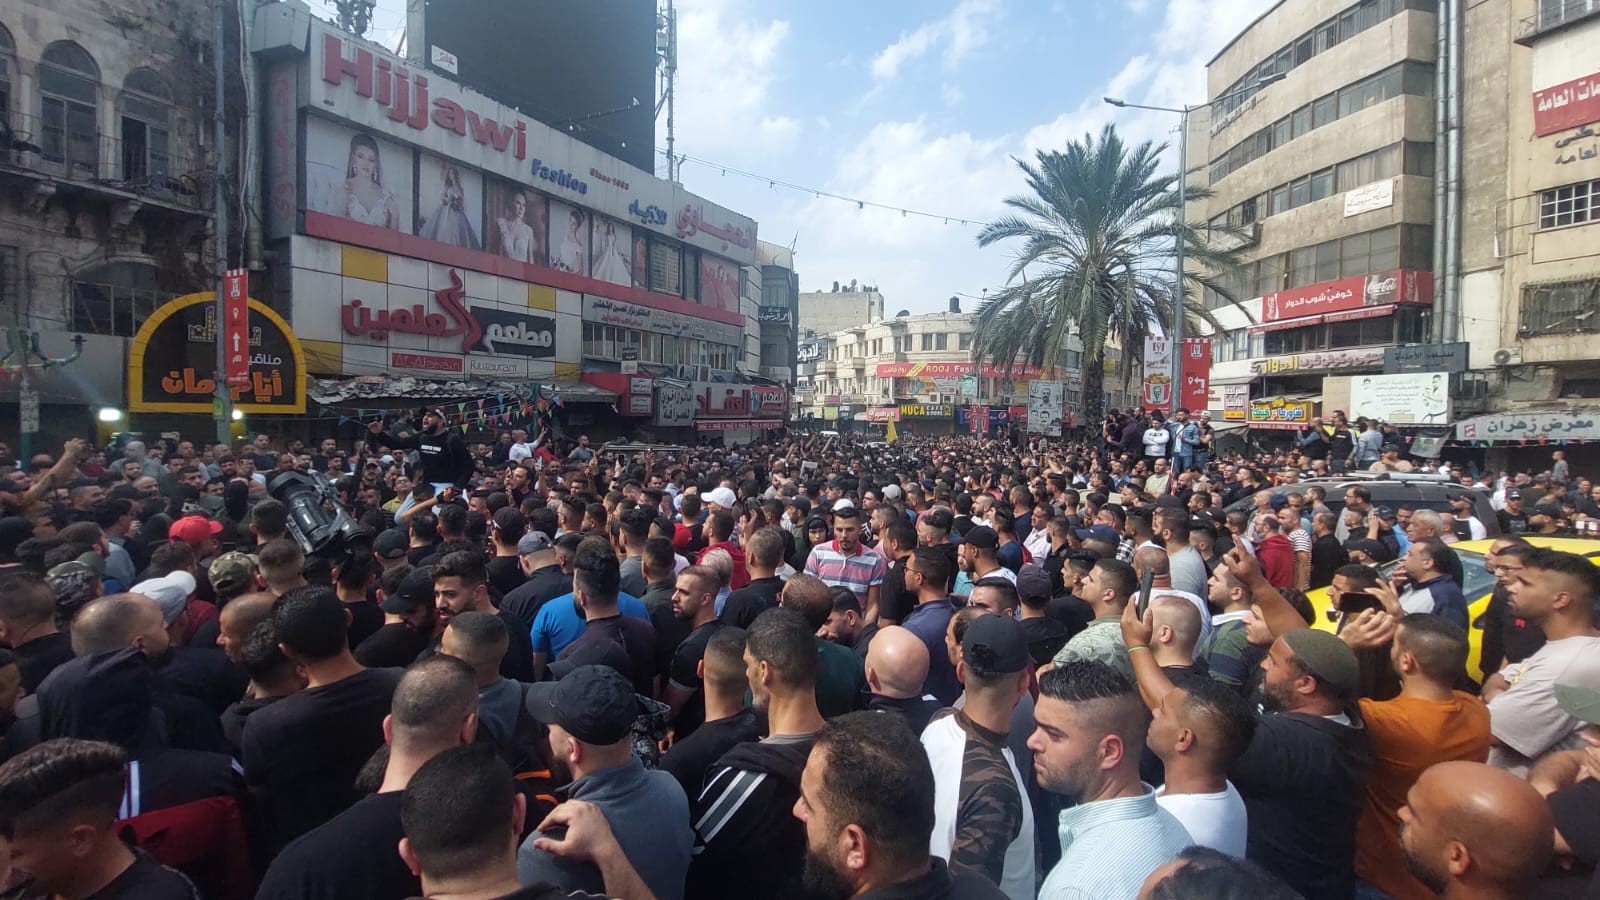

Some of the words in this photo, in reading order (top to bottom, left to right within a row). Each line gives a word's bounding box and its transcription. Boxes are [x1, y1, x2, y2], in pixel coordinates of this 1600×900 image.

[322, 32, 527, 161] Hijjawi
[1536, 86, 1574, 111] العامة
[531, 159, 588, 195] Fashion
[1305, 292, 1326, 305] شوب
[482, 321, 554, 354] مطعم
[248, 353, 282, 365] مناقي
[926, 365, 950, 373] ROOJ
[161, 367, 217, 395] مان
[900, 405, 926, 416] MUCA
[1486, 417, 1538, 434] زهران
[1541, 417, 1595, 433] معرض
